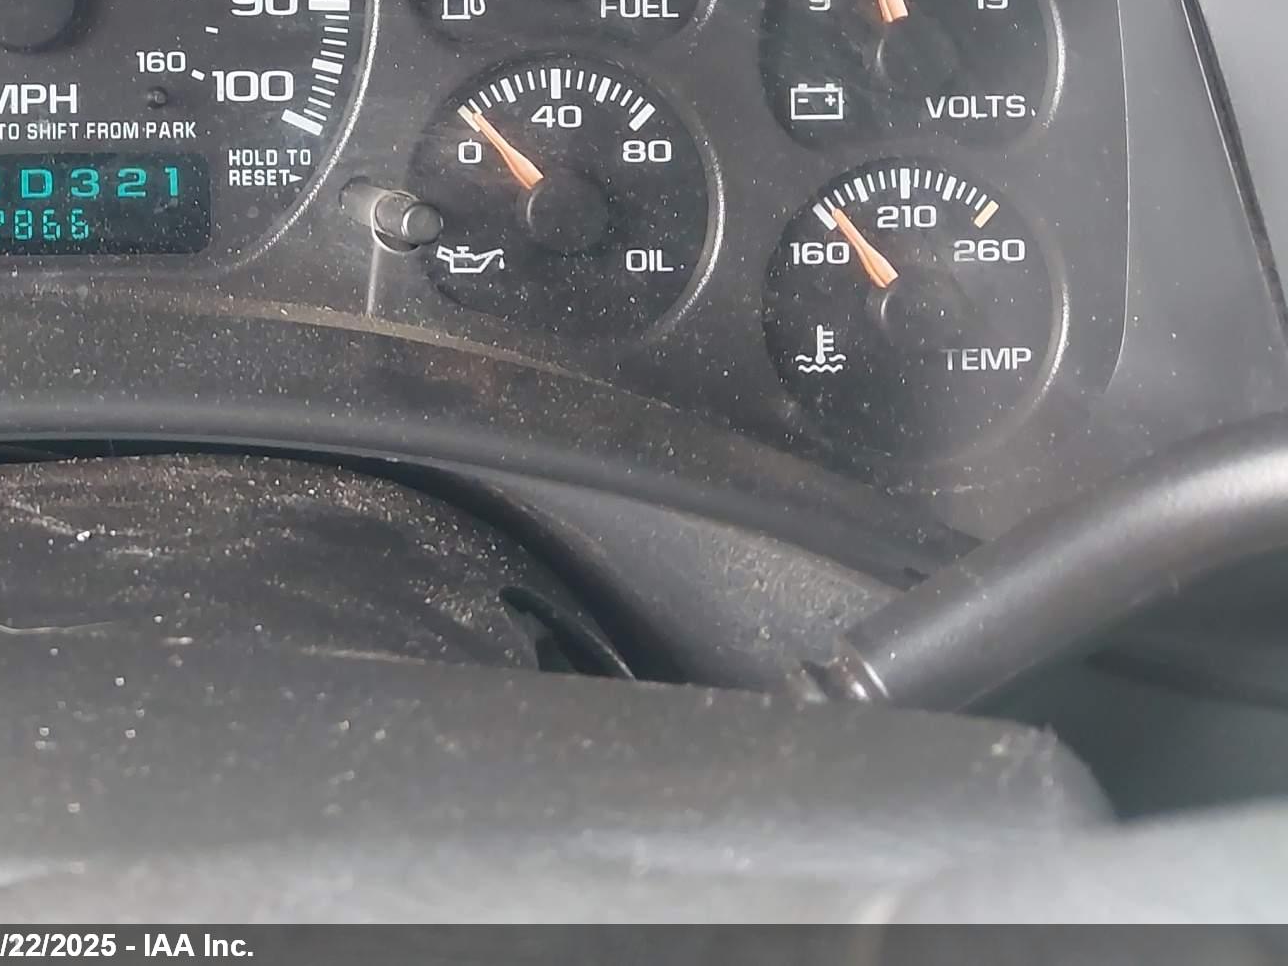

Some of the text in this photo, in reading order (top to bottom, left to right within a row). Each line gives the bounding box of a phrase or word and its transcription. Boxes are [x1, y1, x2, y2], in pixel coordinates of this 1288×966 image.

[136, 51, 187, 73] 160
[212, 70, 295, 103] 100
[531, 104, 583, 129] 40
[925, 95, 1026, 119] VOLTS
[26, 122, 79, 141] SHIFT
[86, 122, 139, 140] FROM
[146, 121, 196, 140] PARK
[228, 148, 312, 167] HOLD TO
[457, 140, 483, 165] 0
[622, 139, 672, 165] 80
[21, 168, 54, 199] D
[70, 167, 100, 198] 3
[117, 167, 147, 198] 2
[164, 166, 180, 197] 1
[228, 168, 290, 188] RESET
[876, 205, 938, 229] 210
[625, 249, 674, 272] OIL
[790, 241, 850, 266] 160
[953, 238, 1026, 263] 260
[941, 347, 1033, 371] TEMP
